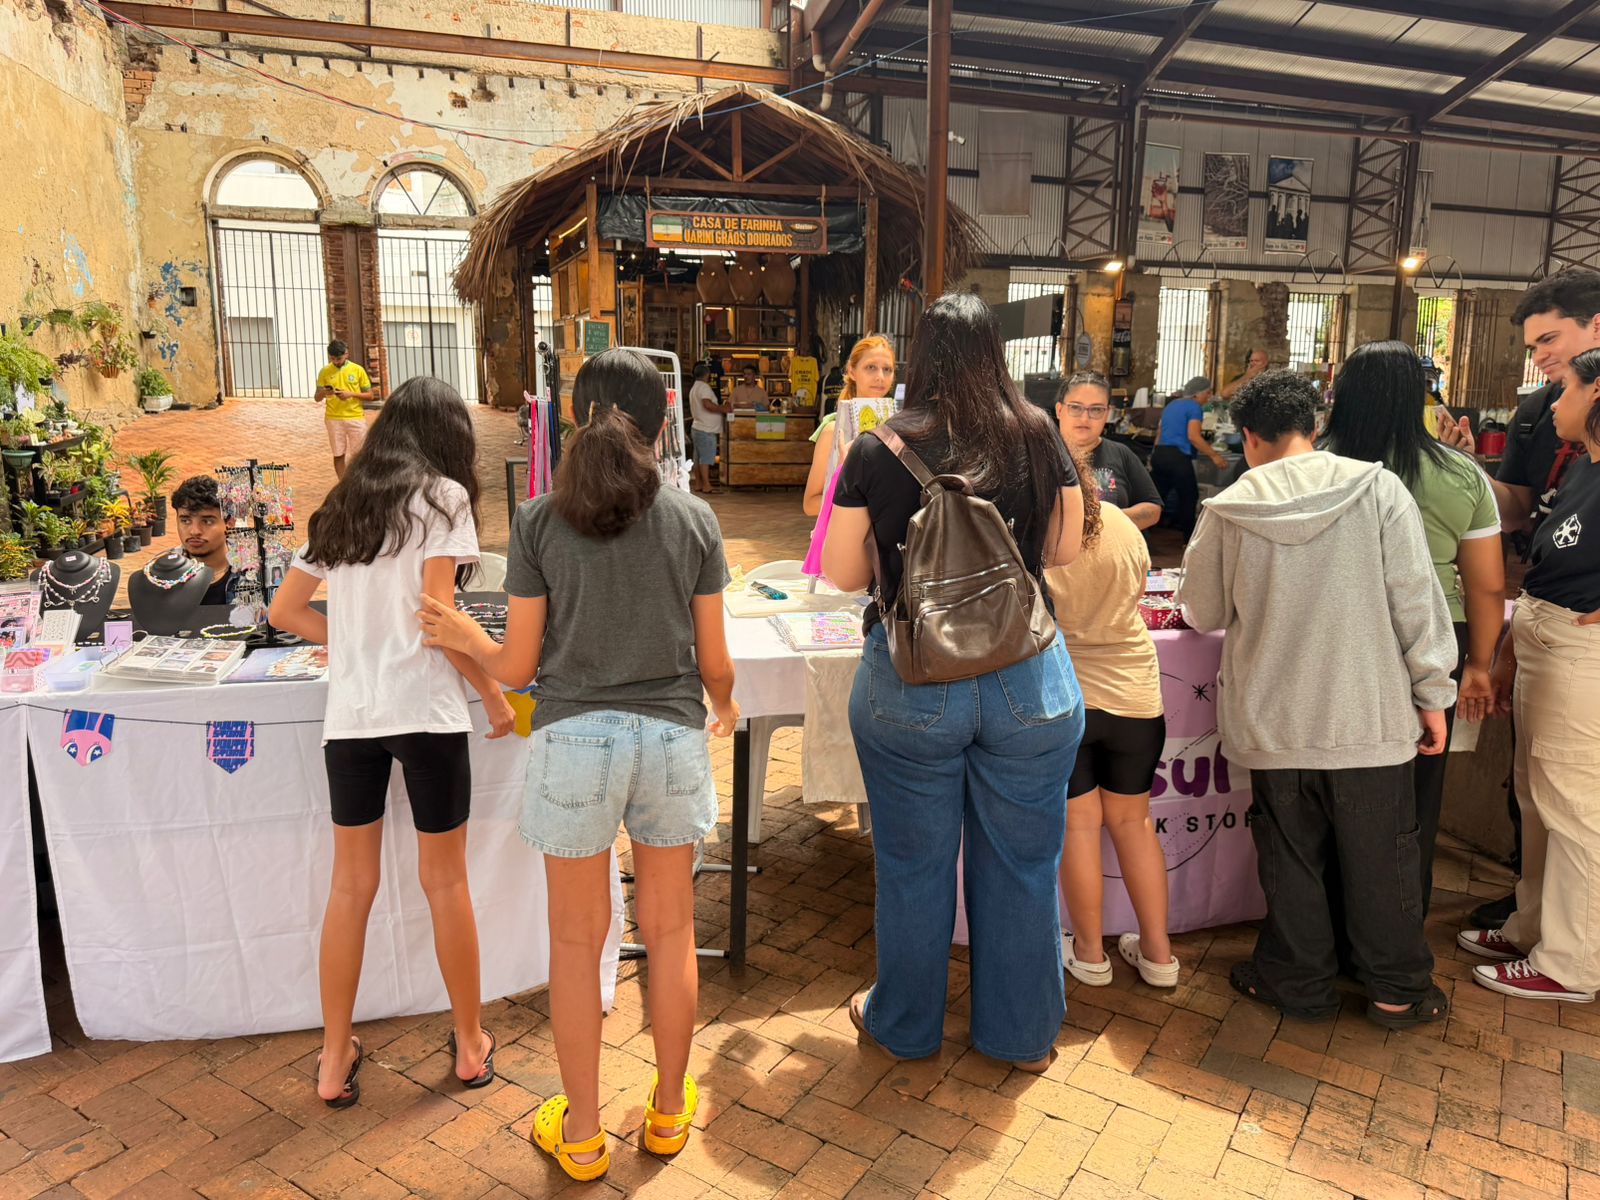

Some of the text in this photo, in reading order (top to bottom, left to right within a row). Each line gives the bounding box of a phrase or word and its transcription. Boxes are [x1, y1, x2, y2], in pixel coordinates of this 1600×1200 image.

[692, 216, 722, 229] CASA
[724, 217, 738, 230] DE
[740, 218, 783, 232] FARINHA
[715, 228, 746, 245] GRÃOS
[747, 231, 793, 247] DOURADOS
